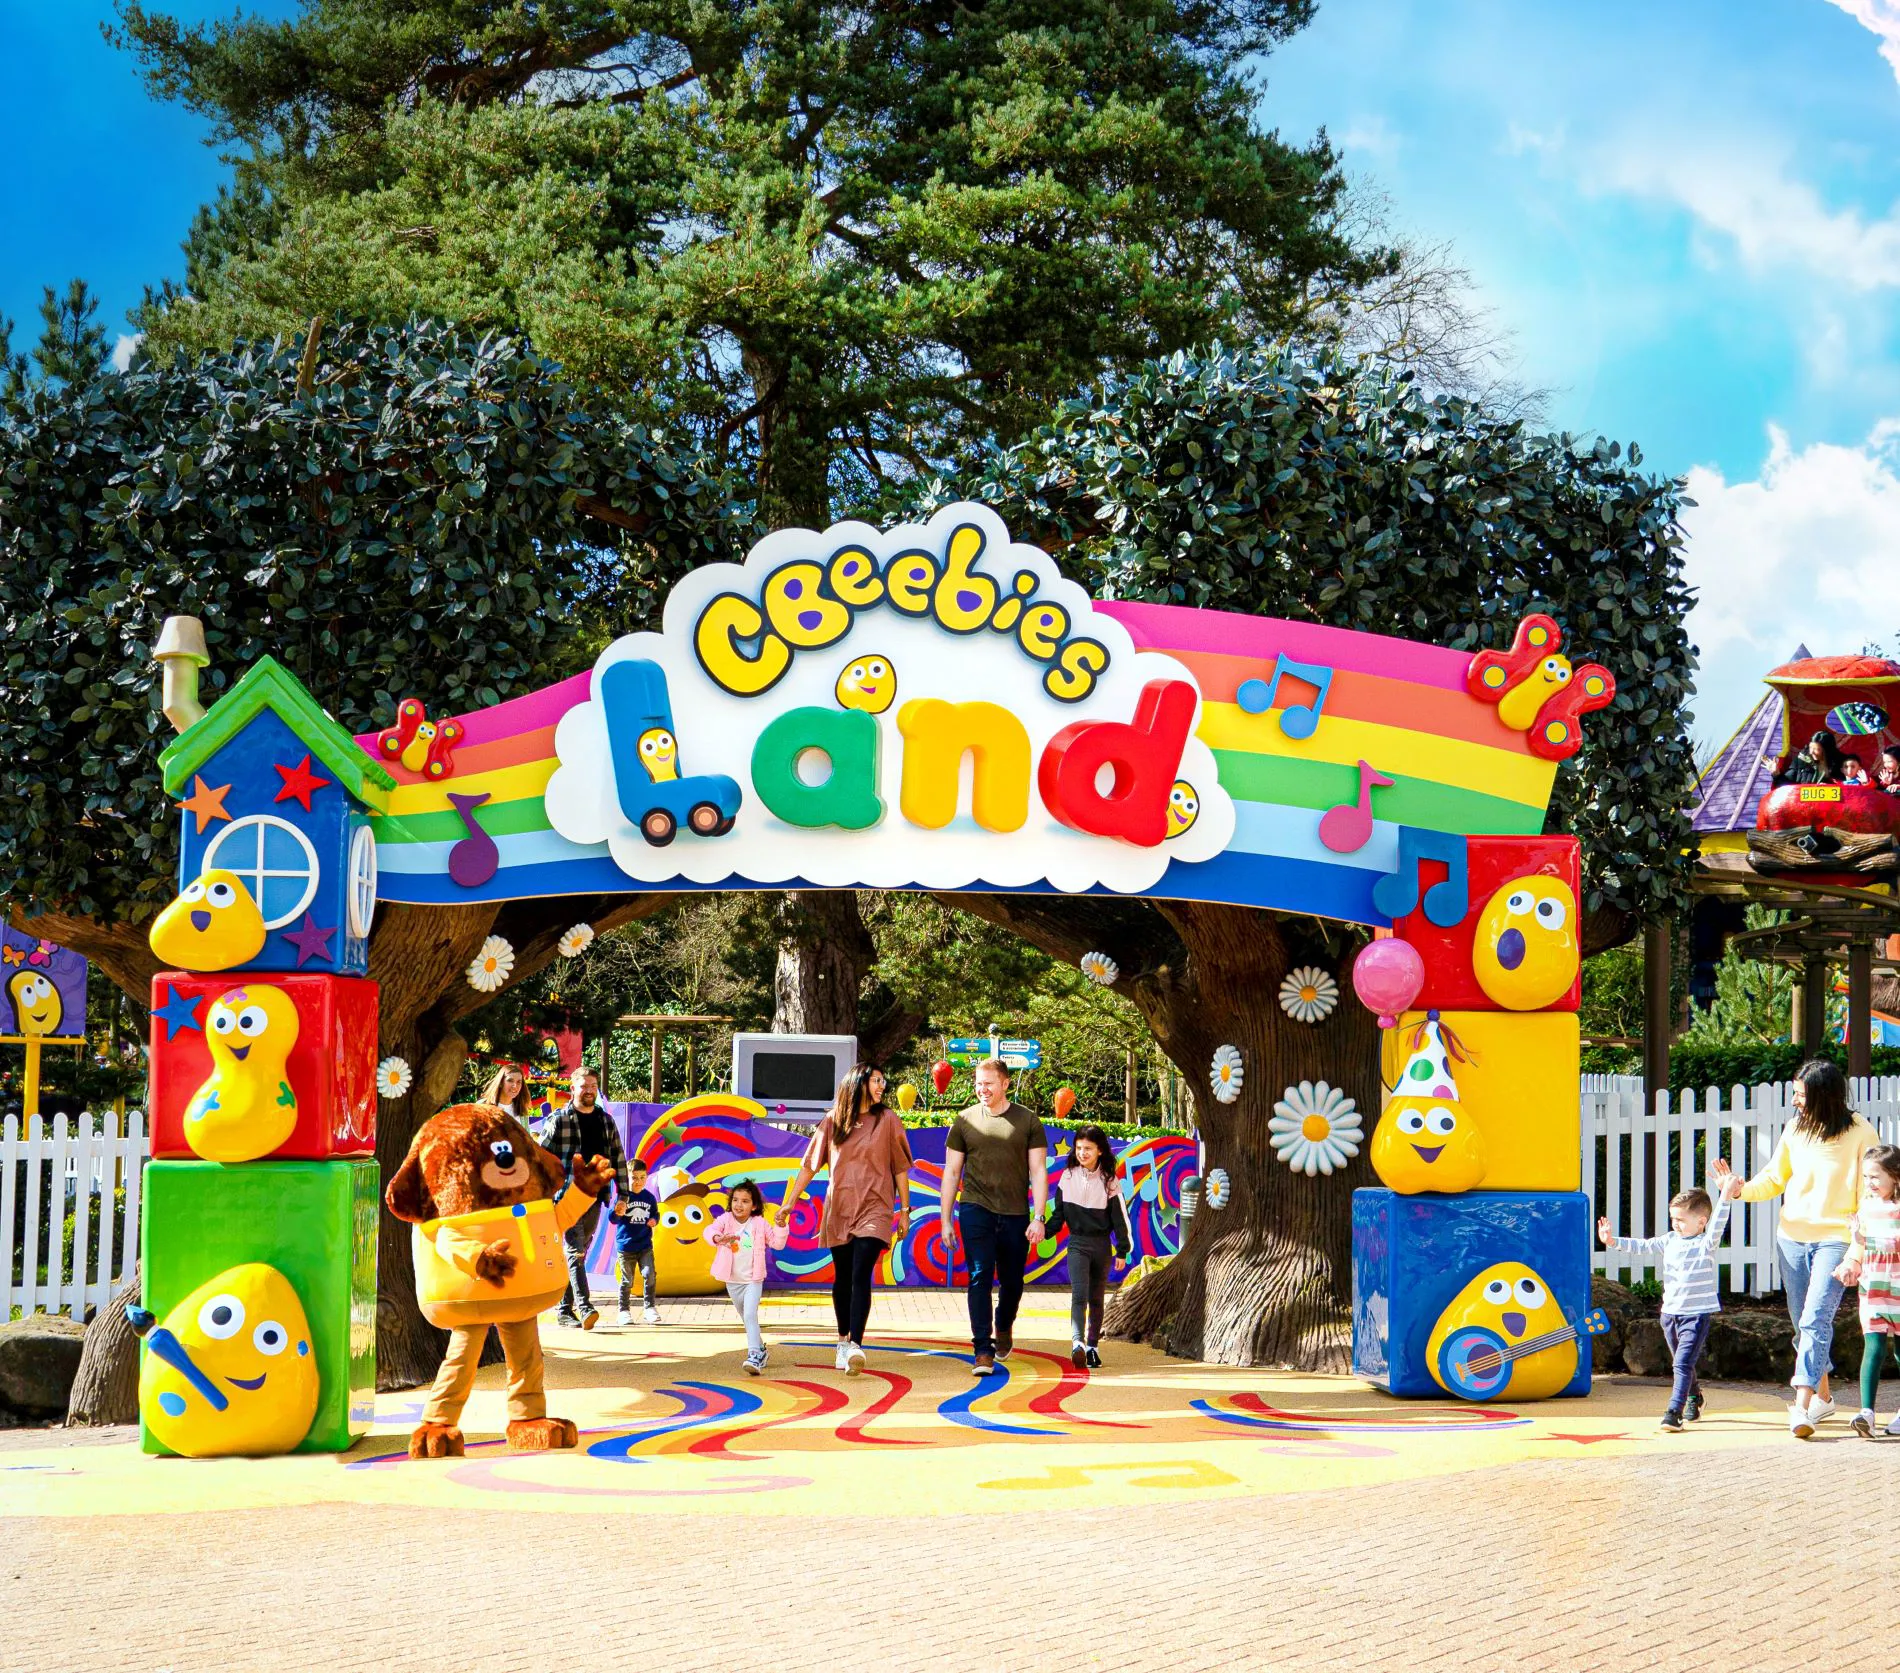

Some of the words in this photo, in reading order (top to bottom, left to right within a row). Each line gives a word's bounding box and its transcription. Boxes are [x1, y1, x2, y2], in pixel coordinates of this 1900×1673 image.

[694, 523, 1110, 703] CBeebies
[601, 658, 1198, 848] Land
[1803, 788, 1825, 799] BUG
[1831, 788, 1838, 799] 3
